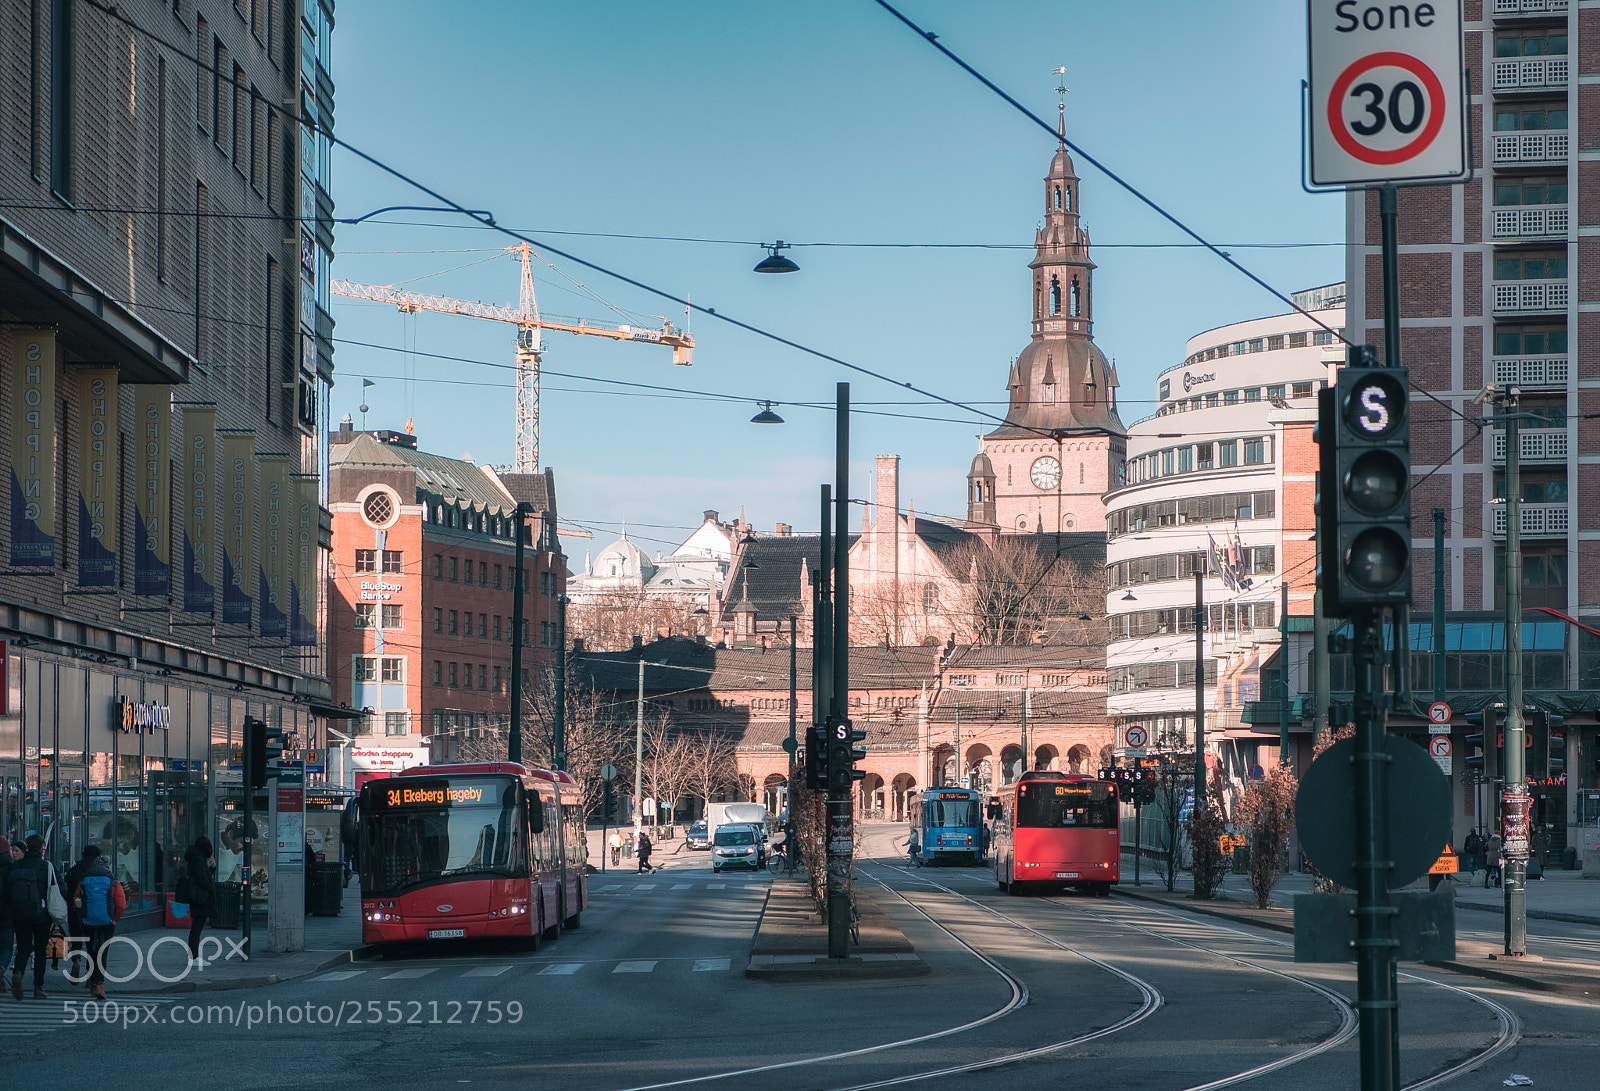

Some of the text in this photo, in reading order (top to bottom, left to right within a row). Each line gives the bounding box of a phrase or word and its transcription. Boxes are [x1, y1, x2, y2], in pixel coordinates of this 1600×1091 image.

[1335, 0, 1436, 32] Sone
[1351, 80, 1425, 136] 30
[1360, 385, 1390, 432] S
[361, 581, 402, 593] BlueStep
[361, 591, 385, 600] Bank
[837, 725, 847, 740] S
[381, 750, 414, 759] shopping
[387, 787, 482, 806] 34 Ekeberg hageby
[1055, 787, 1064, 795] 60
